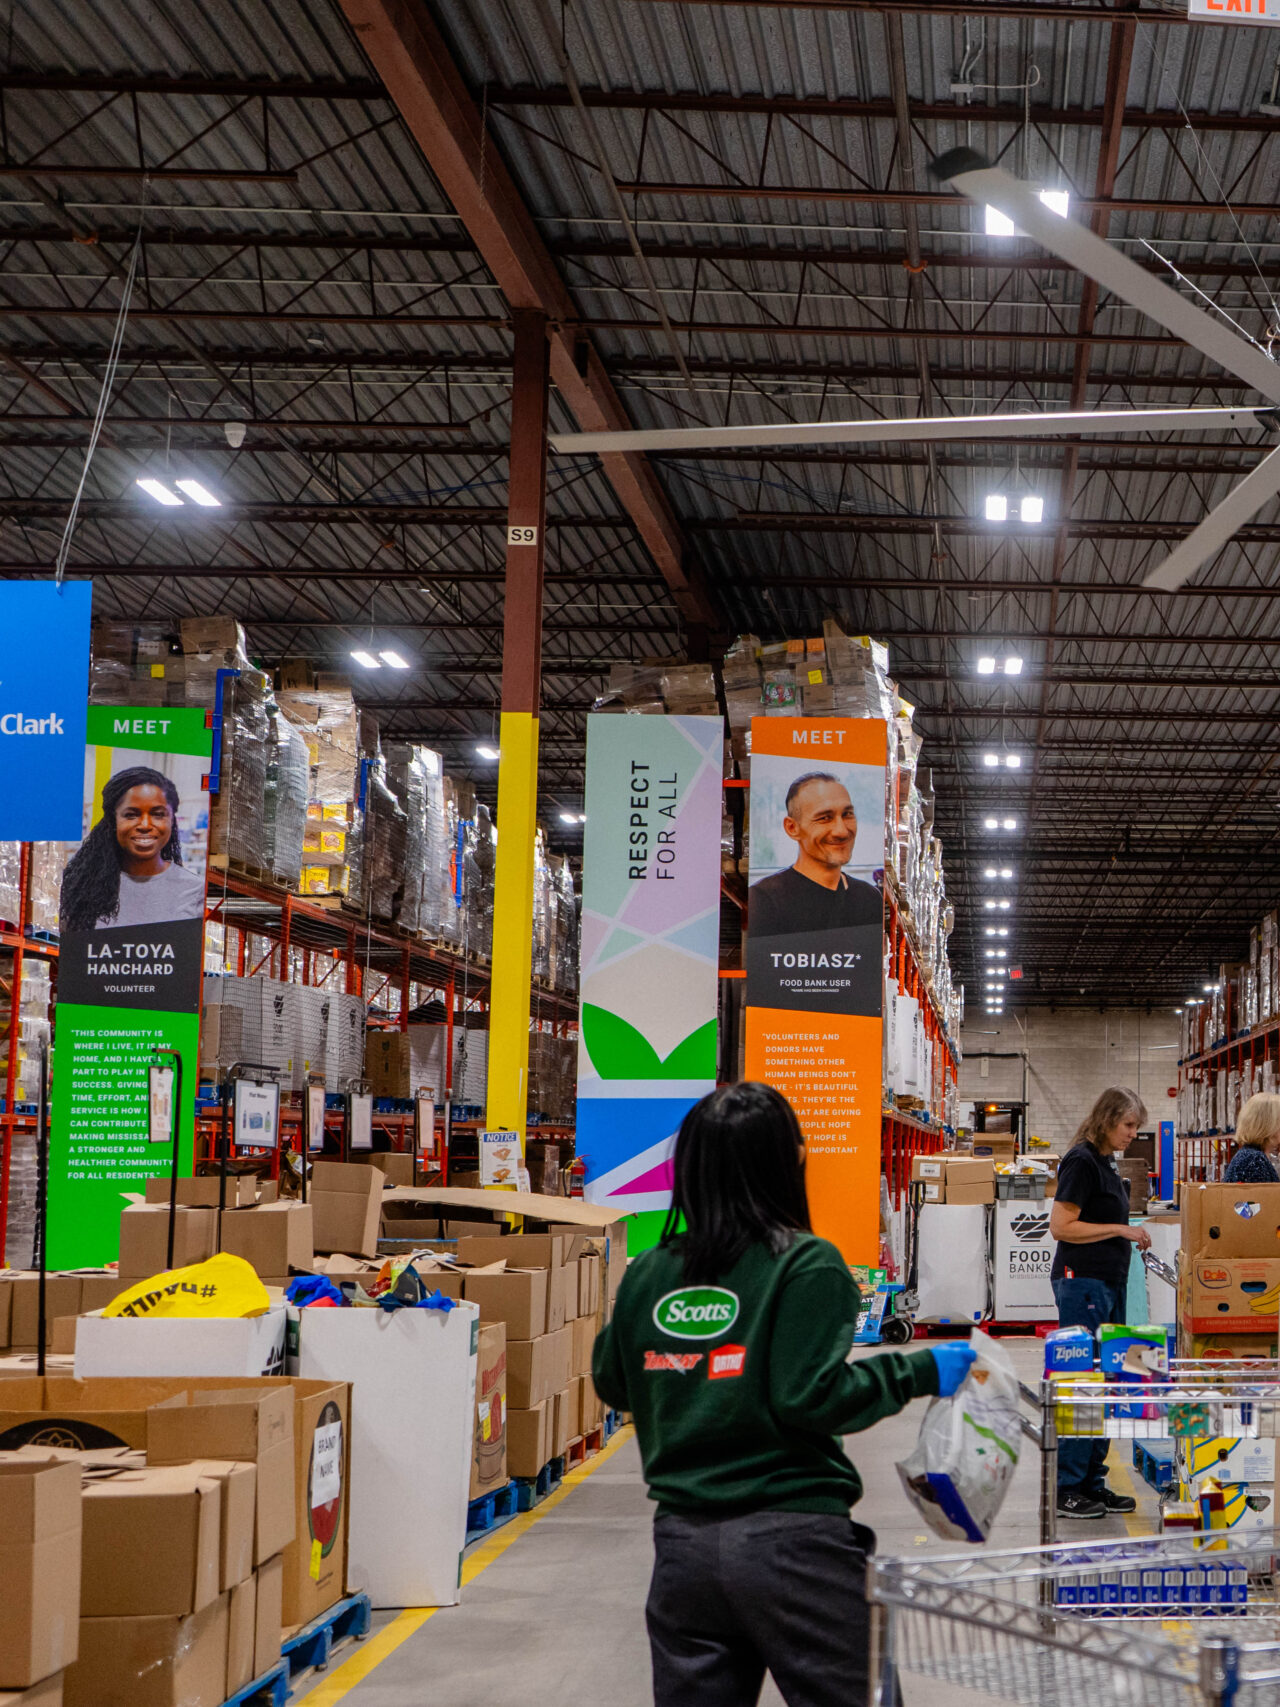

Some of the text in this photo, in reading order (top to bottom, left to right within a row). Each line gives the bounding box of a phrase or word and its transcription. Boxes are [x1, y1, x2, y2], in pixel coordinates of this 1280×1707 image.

[511, 529, 534, 541] S9
[113, 719, 172, 735] MEET
[793, 730, 846, 744] MEET
[629, 760, 650, 879] RESPECT
[656, 772, 677, 880] FOR ALL
[87, 943, 175, 959] LA-TOYA
[87, 963, 173, 975] HANCHARD
[780, 979, 851, 987] FOOD BANK USER
[104, 985, 155, 993] VOLUNTEER
[98, 1029, 152, 1037] COMMUNITY
[154, 1029, 163, 1037] IS
[112, 1043, 134, 1051] LIVE,
[73, 1056, 101, 1064] HOME,
[71, 1095, 95, 1103] TIME,
[97, 1095, 132, 1103] EFFORT,
[487, 1133, 515, 1141] NOTICE
[1009, 1251, 1051, 1262] FOOD
[1009, 1264, 1051, 1273] BANKS
[1203, 1270, 1227, 1280] Dole
[666, 1300, 731, 1323] Scotts
[1055, 1347, 1089, 1362] Ziploc
[319, 1461, 334, 1478] NAME
